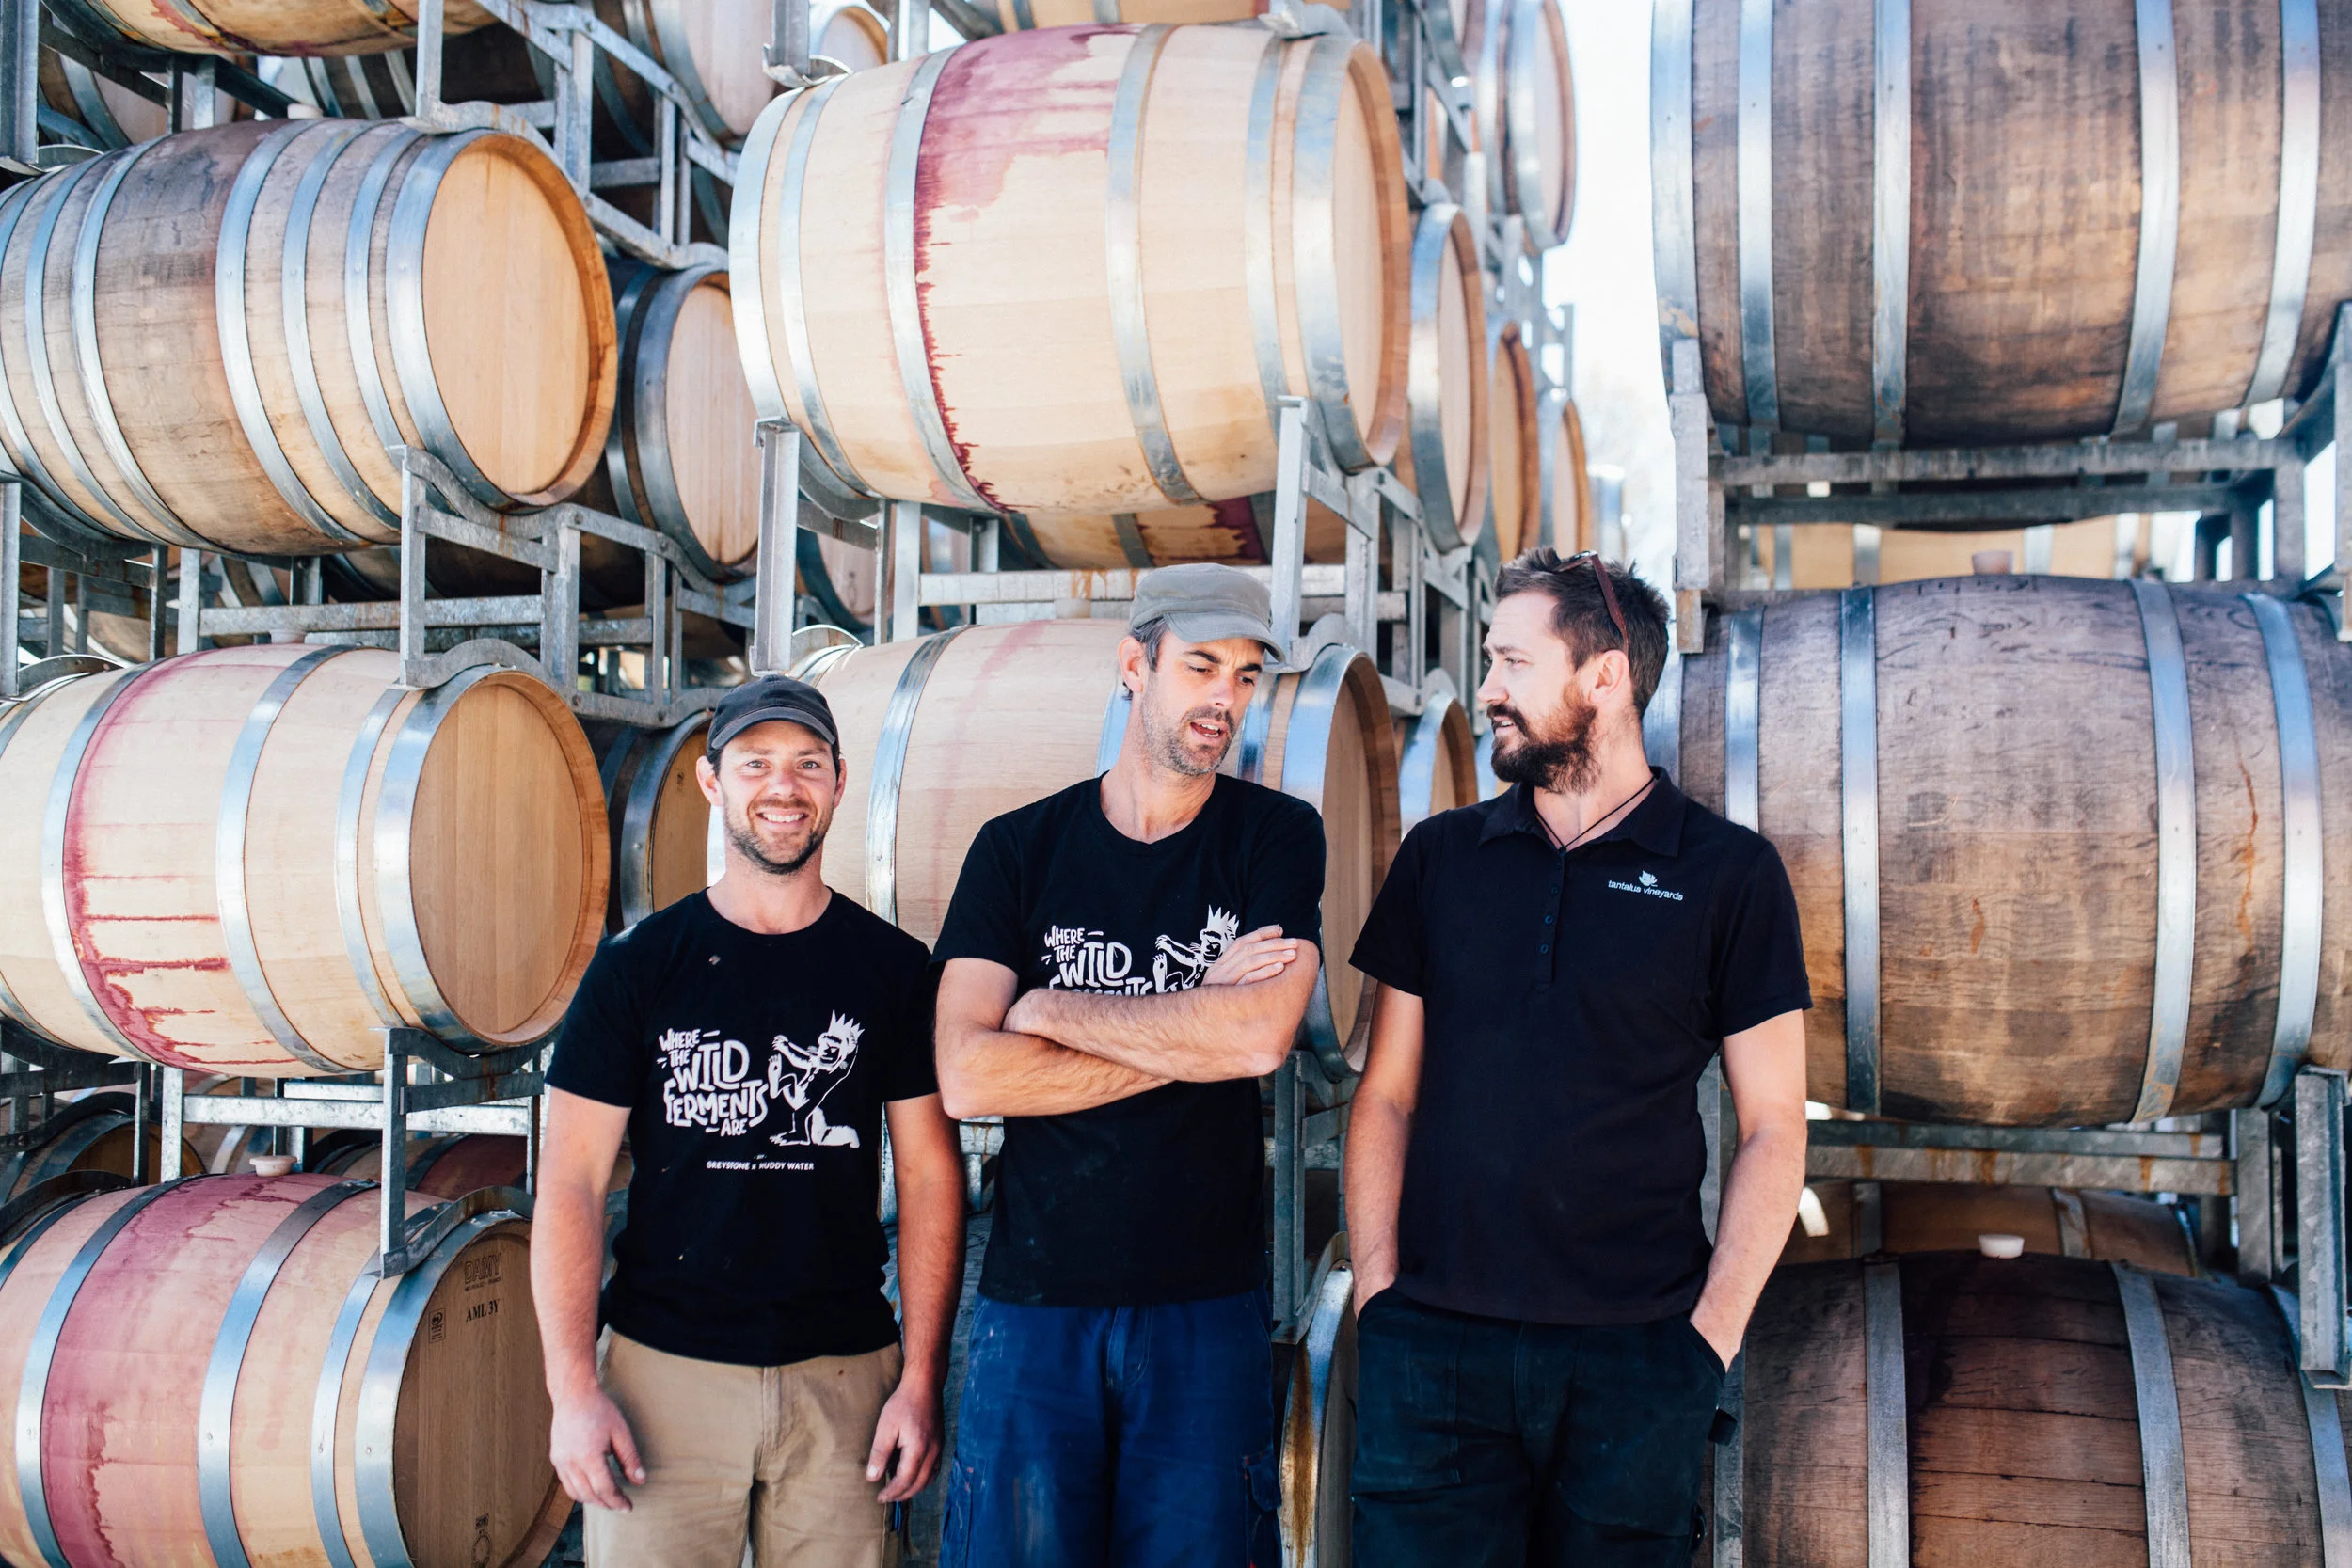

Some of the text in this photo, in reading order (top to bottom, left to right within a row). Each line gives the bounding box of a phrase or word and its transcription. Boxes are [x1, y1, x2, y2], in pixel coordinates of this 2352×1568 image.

[1608, 879, 1683, 901] tantalus vineyards
[1044, 925, 1085, 947] WHERE
[1053, 945, 1075, 963] THE
[1059, 942, 1132, 988] WILD
[659, 1028, 701, 1052] WHERE
[667, 1049, 691, 1067] THE
[674, 1039, 751, 1093] WILD
[663, 1078, 769, 1127] FERMENTS
[720, 1118, 747, 1137] ARE
[706, 1160, 751, 1170] GREYSTONE
[758, 1162, 787, 1170] MUDDY
[787, 1162, 815, 1171] WATER
[466, 1303, 487, 1323] AML
